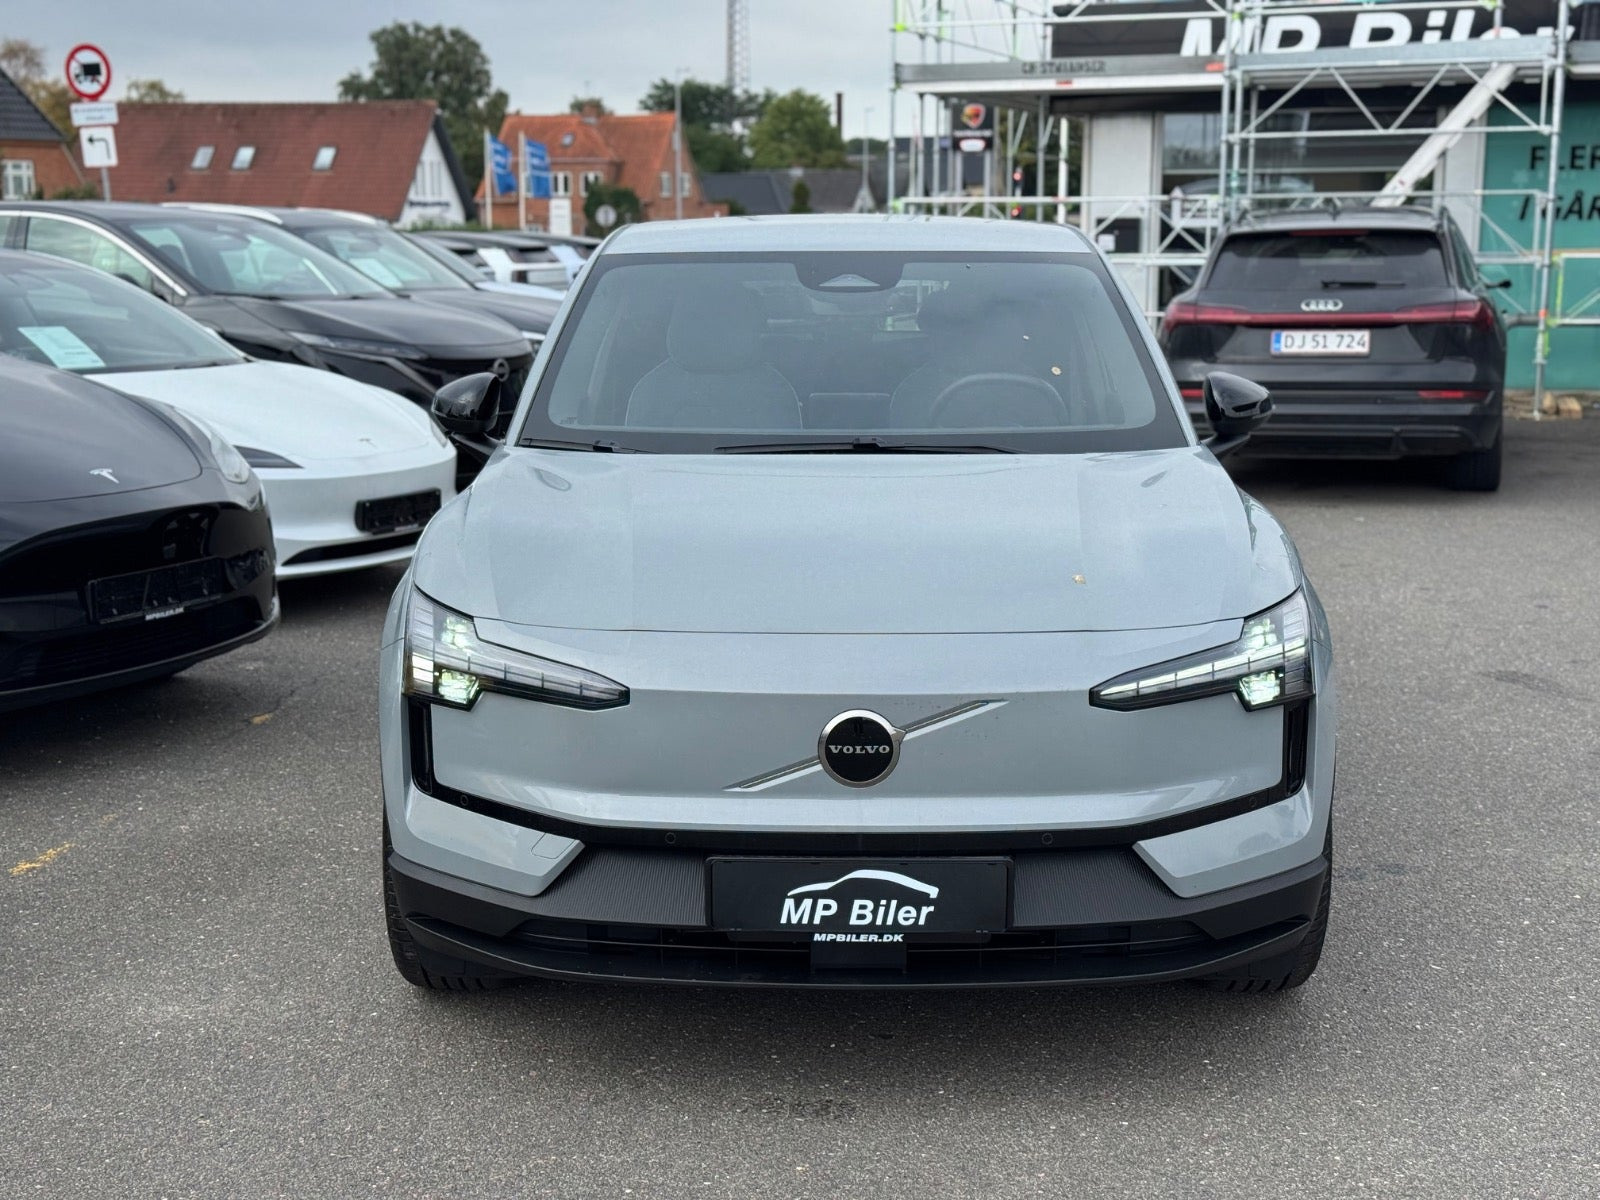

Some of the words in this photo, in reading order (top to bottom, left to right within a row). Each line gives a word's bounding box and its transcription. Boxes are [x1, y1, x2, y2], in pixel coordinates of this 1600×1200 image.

[828, 745, 890, 754] VOLVO
[779, 897, 838, 925] MP
[848, 899, 935, 926] Biler
[812, 932, 904, 942] MPBILER.DK
